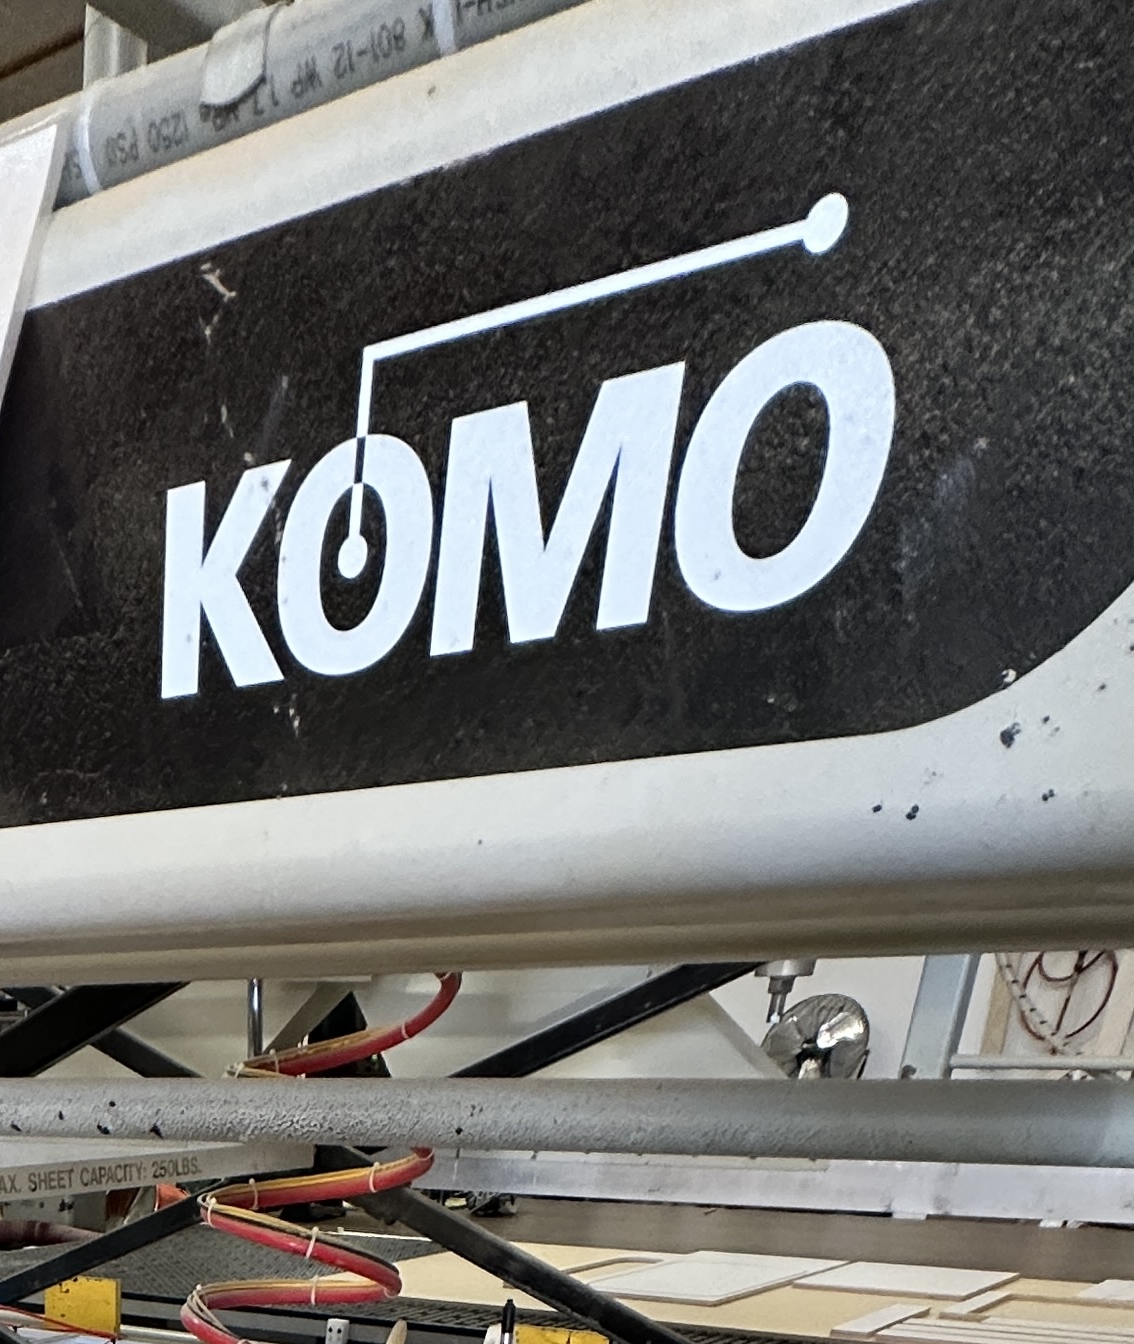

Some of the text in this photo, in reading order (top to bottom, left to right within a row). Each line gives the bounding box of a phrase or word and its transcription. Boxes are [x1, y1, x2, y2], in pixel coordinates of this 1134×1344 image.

[160, 318, 896, 700] KOMO
[27, 1168, 75, 1193] SHEET
[79, 1162, 147, 1188] CAPACITY:
[151, 1156, 203, 1180] 250LBS.
